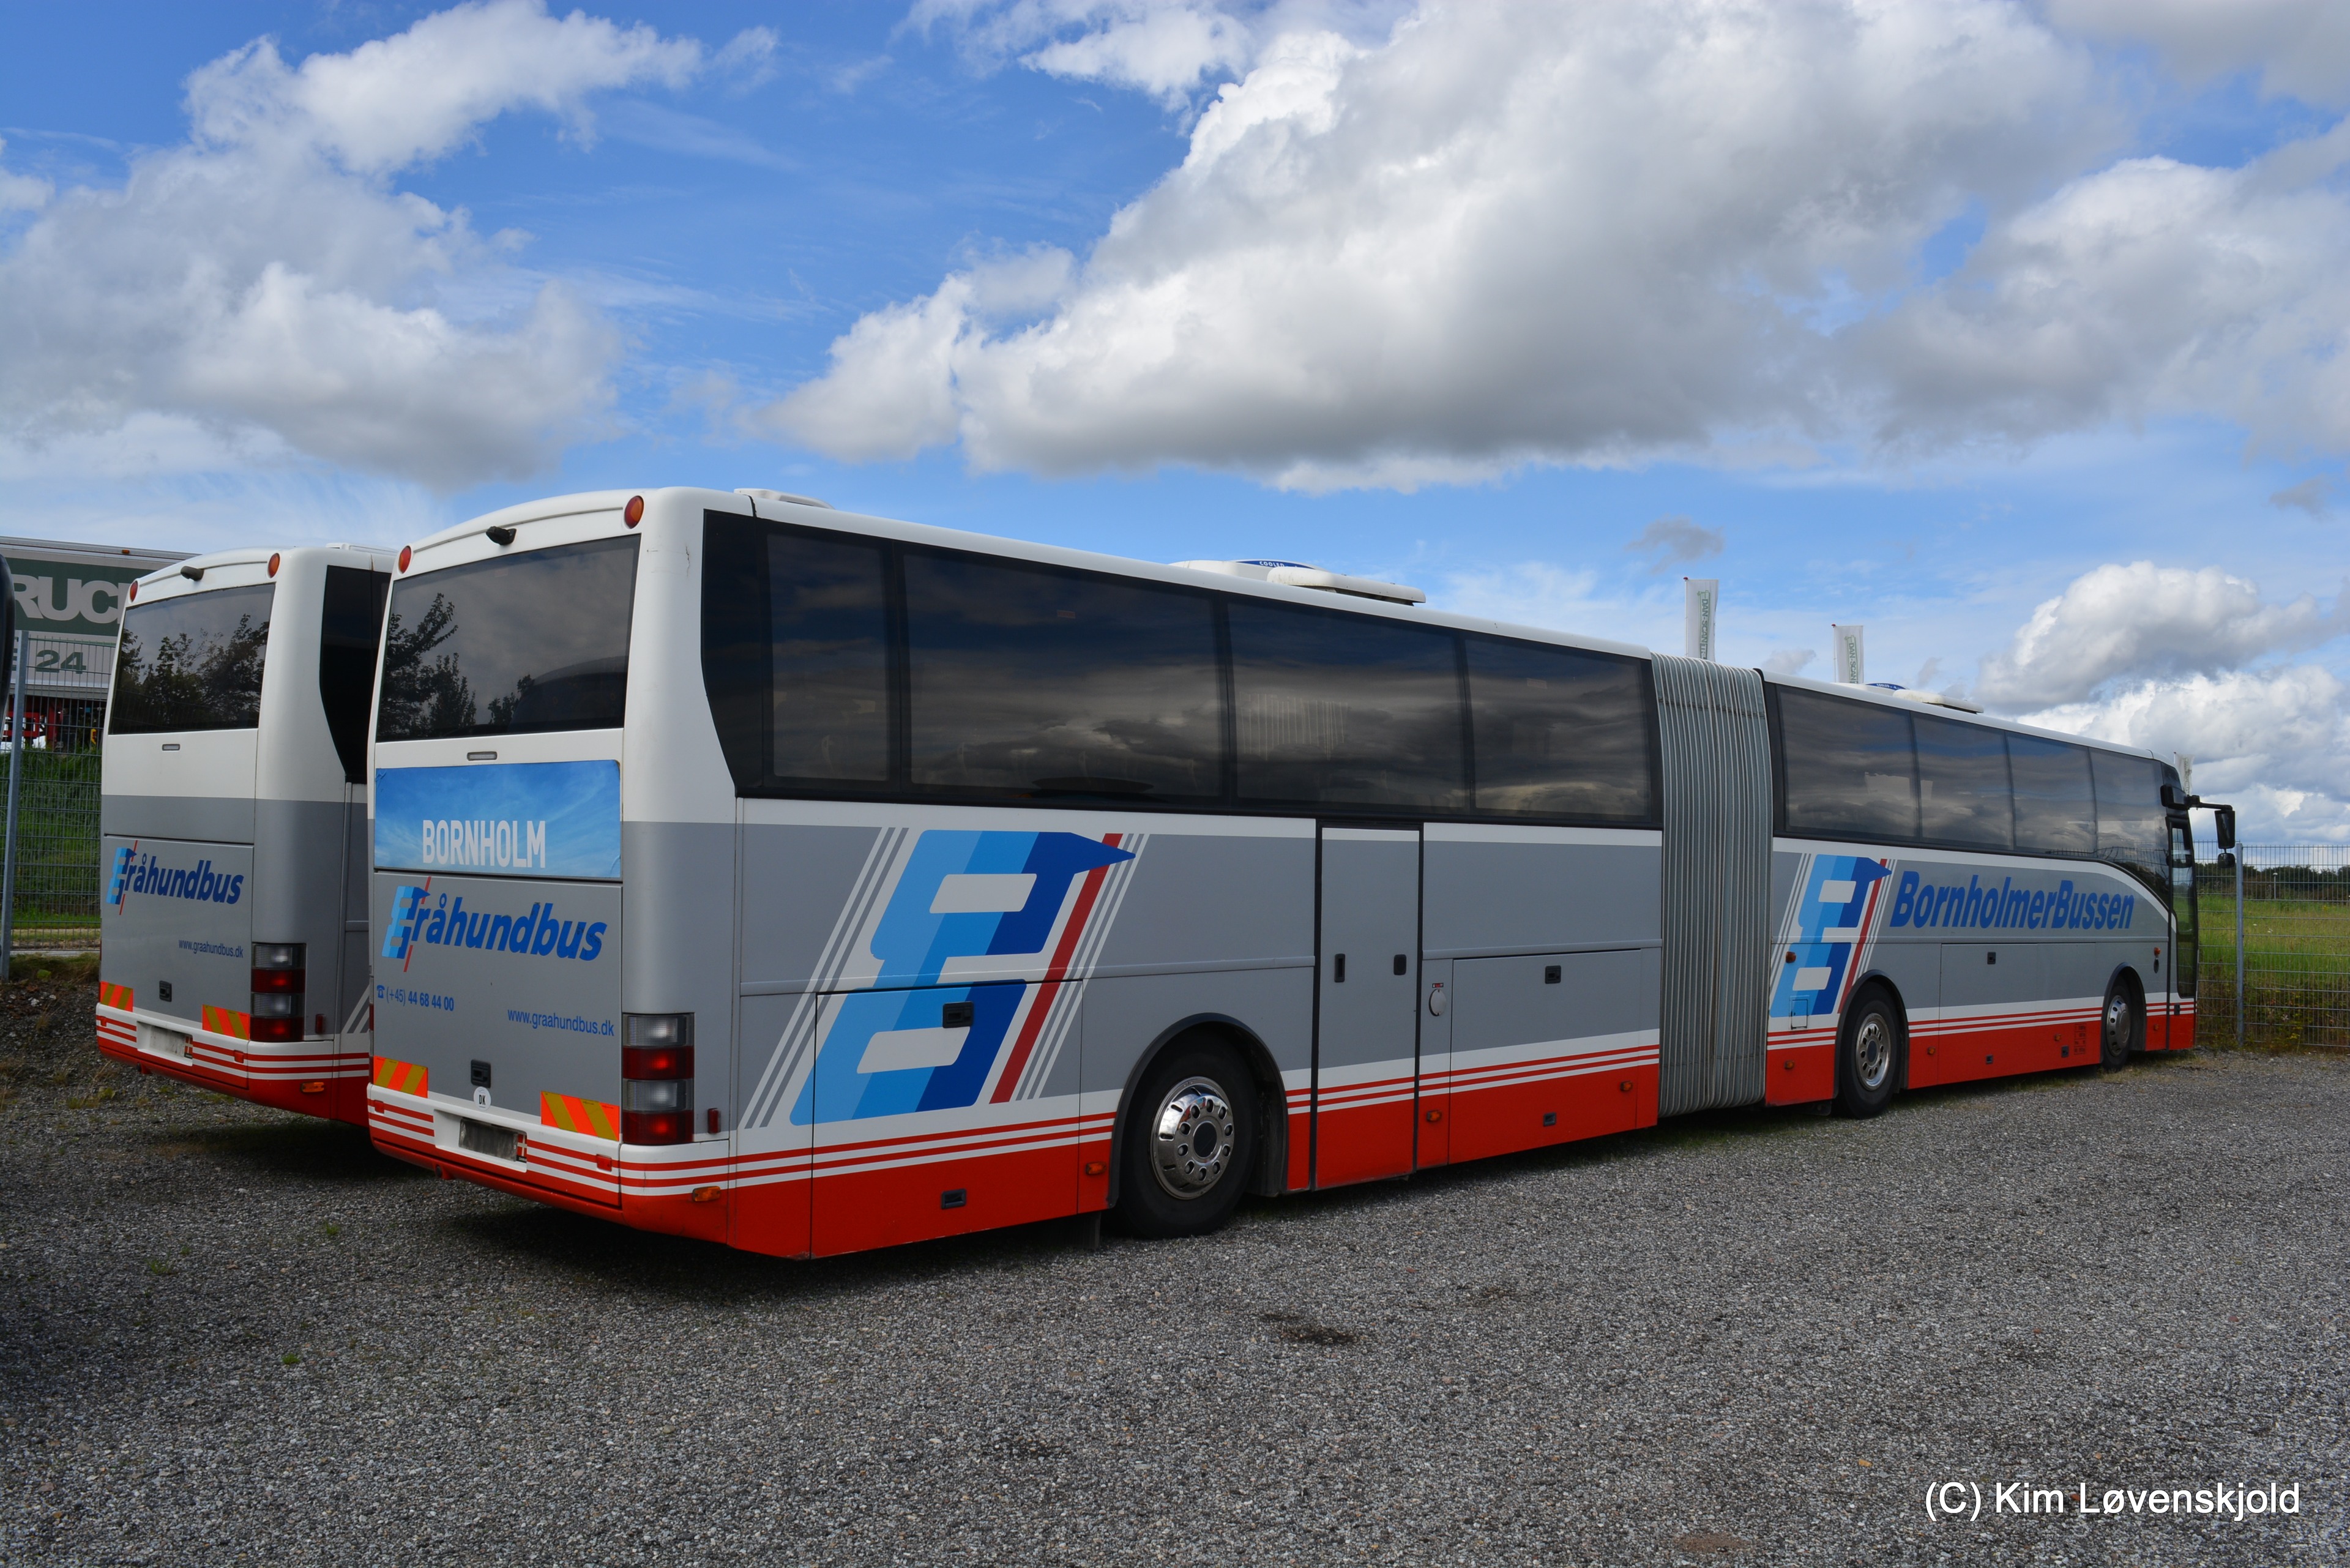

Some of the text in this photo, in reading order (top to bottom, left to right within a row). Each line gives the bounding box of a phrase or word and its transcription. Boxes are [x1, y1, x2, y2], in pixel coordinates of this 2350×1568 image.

[35, 649, 87, 674] 24
[422, 819, 545, 868] BORNHOLM
[1889, 871, 2135, 930] BornholmerBussen
[178, 939, 244, 958] www.graahundbus.dk
[386, 986, 455, 1012] (+45) 44 68 44 00
[507, 1009, 614, 1037] www.graahundbus.dk
[479, 1094, 487, 1105] DK
